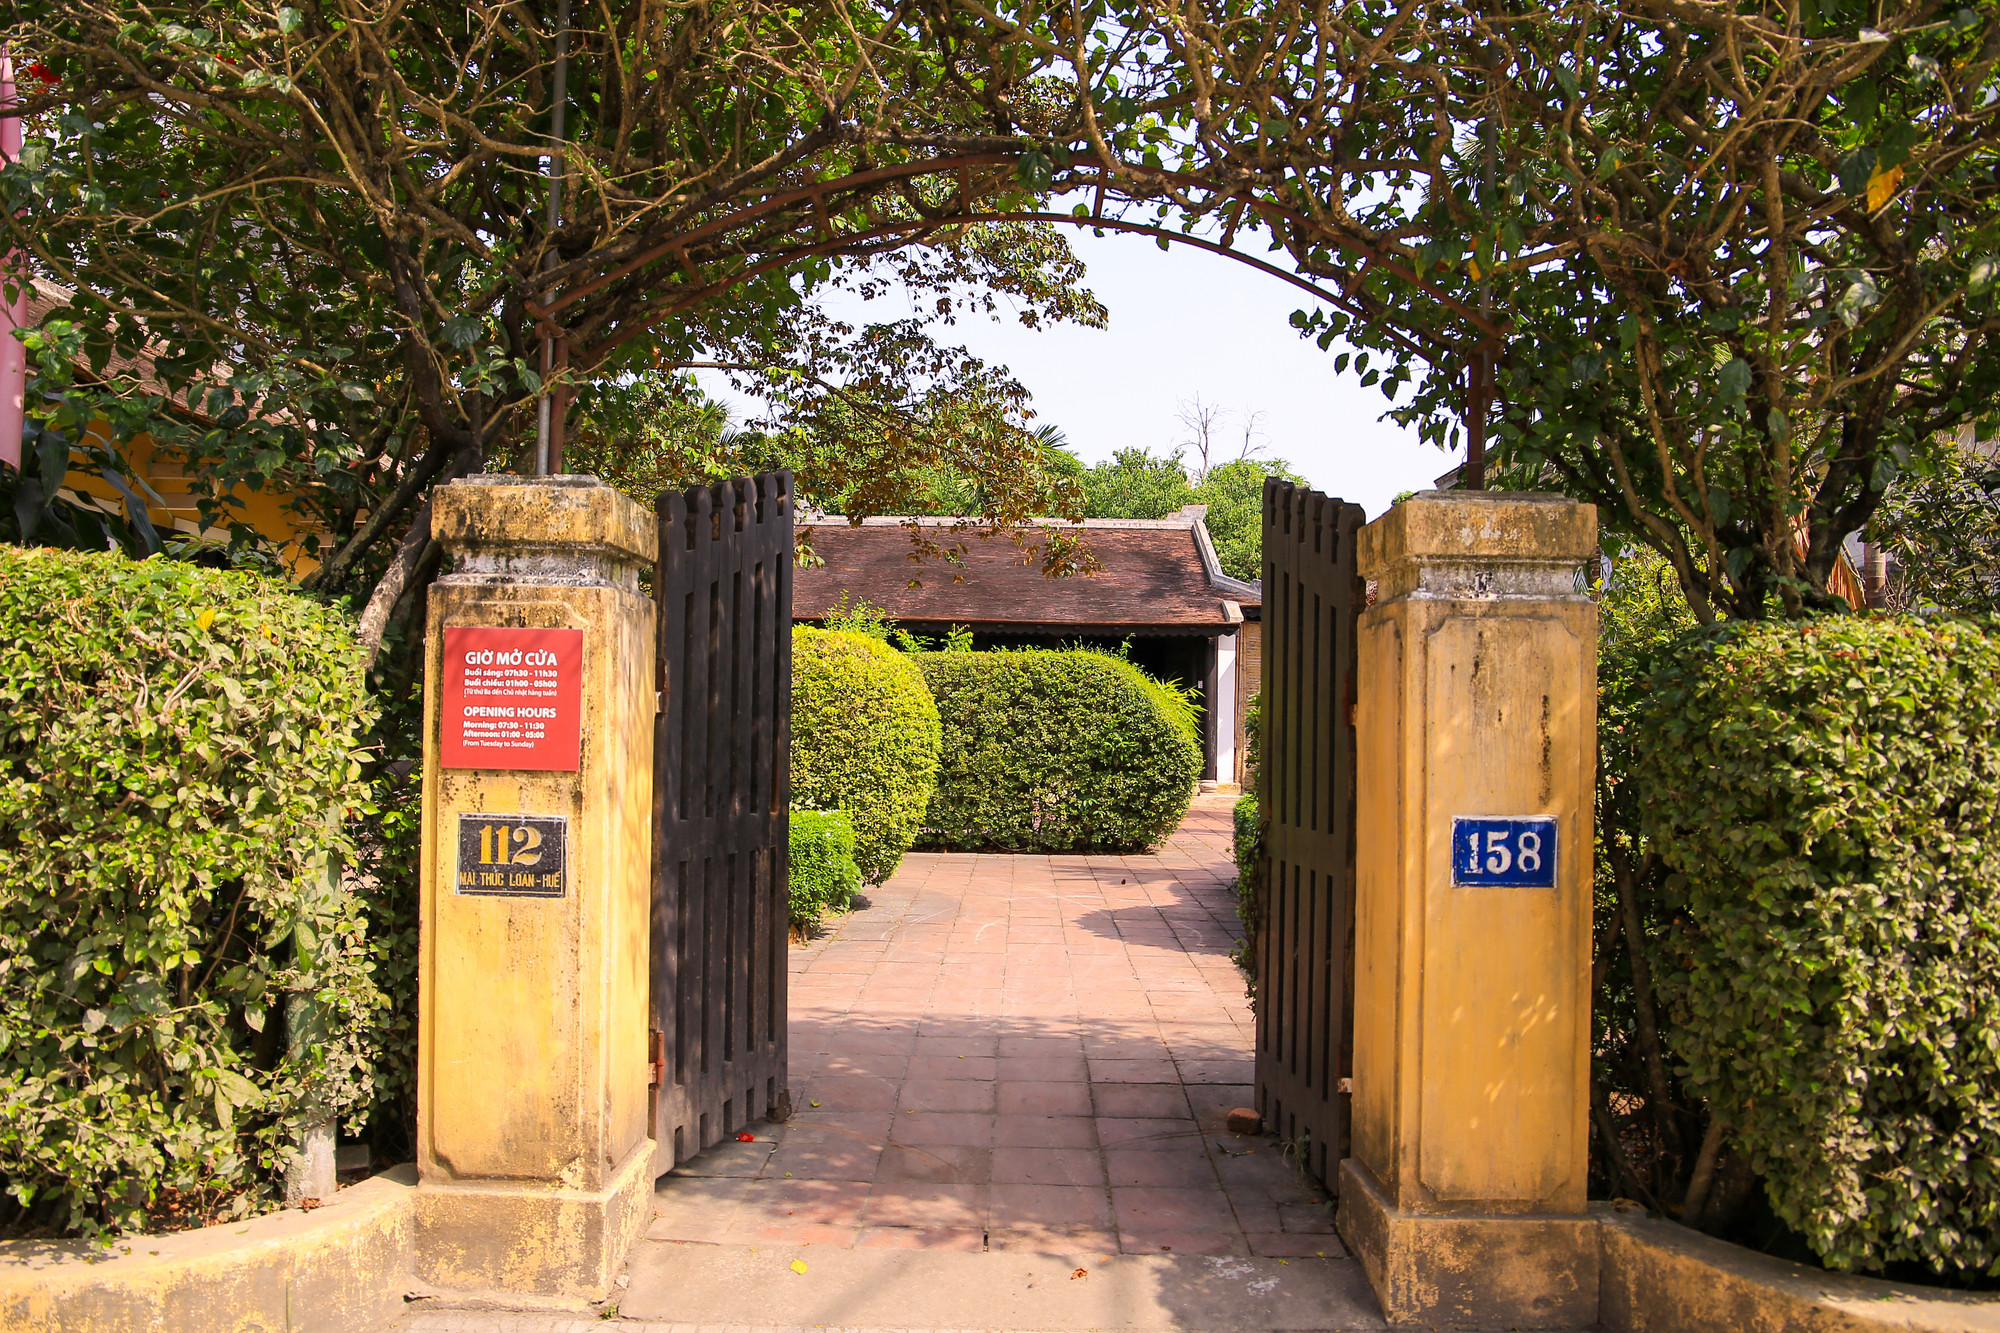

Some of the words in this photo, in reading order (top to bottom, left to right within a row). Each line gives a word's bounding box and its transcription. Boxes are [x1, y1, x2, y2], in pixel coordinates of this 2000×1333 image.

[465, 649, 494, 665] GIỜ
[496, 648, 523, 665] MỞ
[525, 648, 558, 666] CỬA
[464, 668, 482, 676] Buổi
[483, 669, 503, 678] sáng:
[504, 669, 528, 677] 07h30
[464, 678, 482, 686] Buổi
[533, 680, 557, 688] 05h00
[463, 706, 515, 717] OPENING
[516, 707, 557, 718] HOURS
[463, 721, 497, 730] Morning:
[524, 722, 545, 730] 11:30
[463, 730, 500, 738] Afternoon:
[525, 731, 545, 739] 05:00
[479, 740, 503, 748] Tuesday
[511, 741, 534, 749] Sunday)
[478, 825, 542, 866] 112
[1464, 829, 1541, 875] 158
[459, 871, 476, 886] MAI
[509, 873, 535, 887] LOAN
